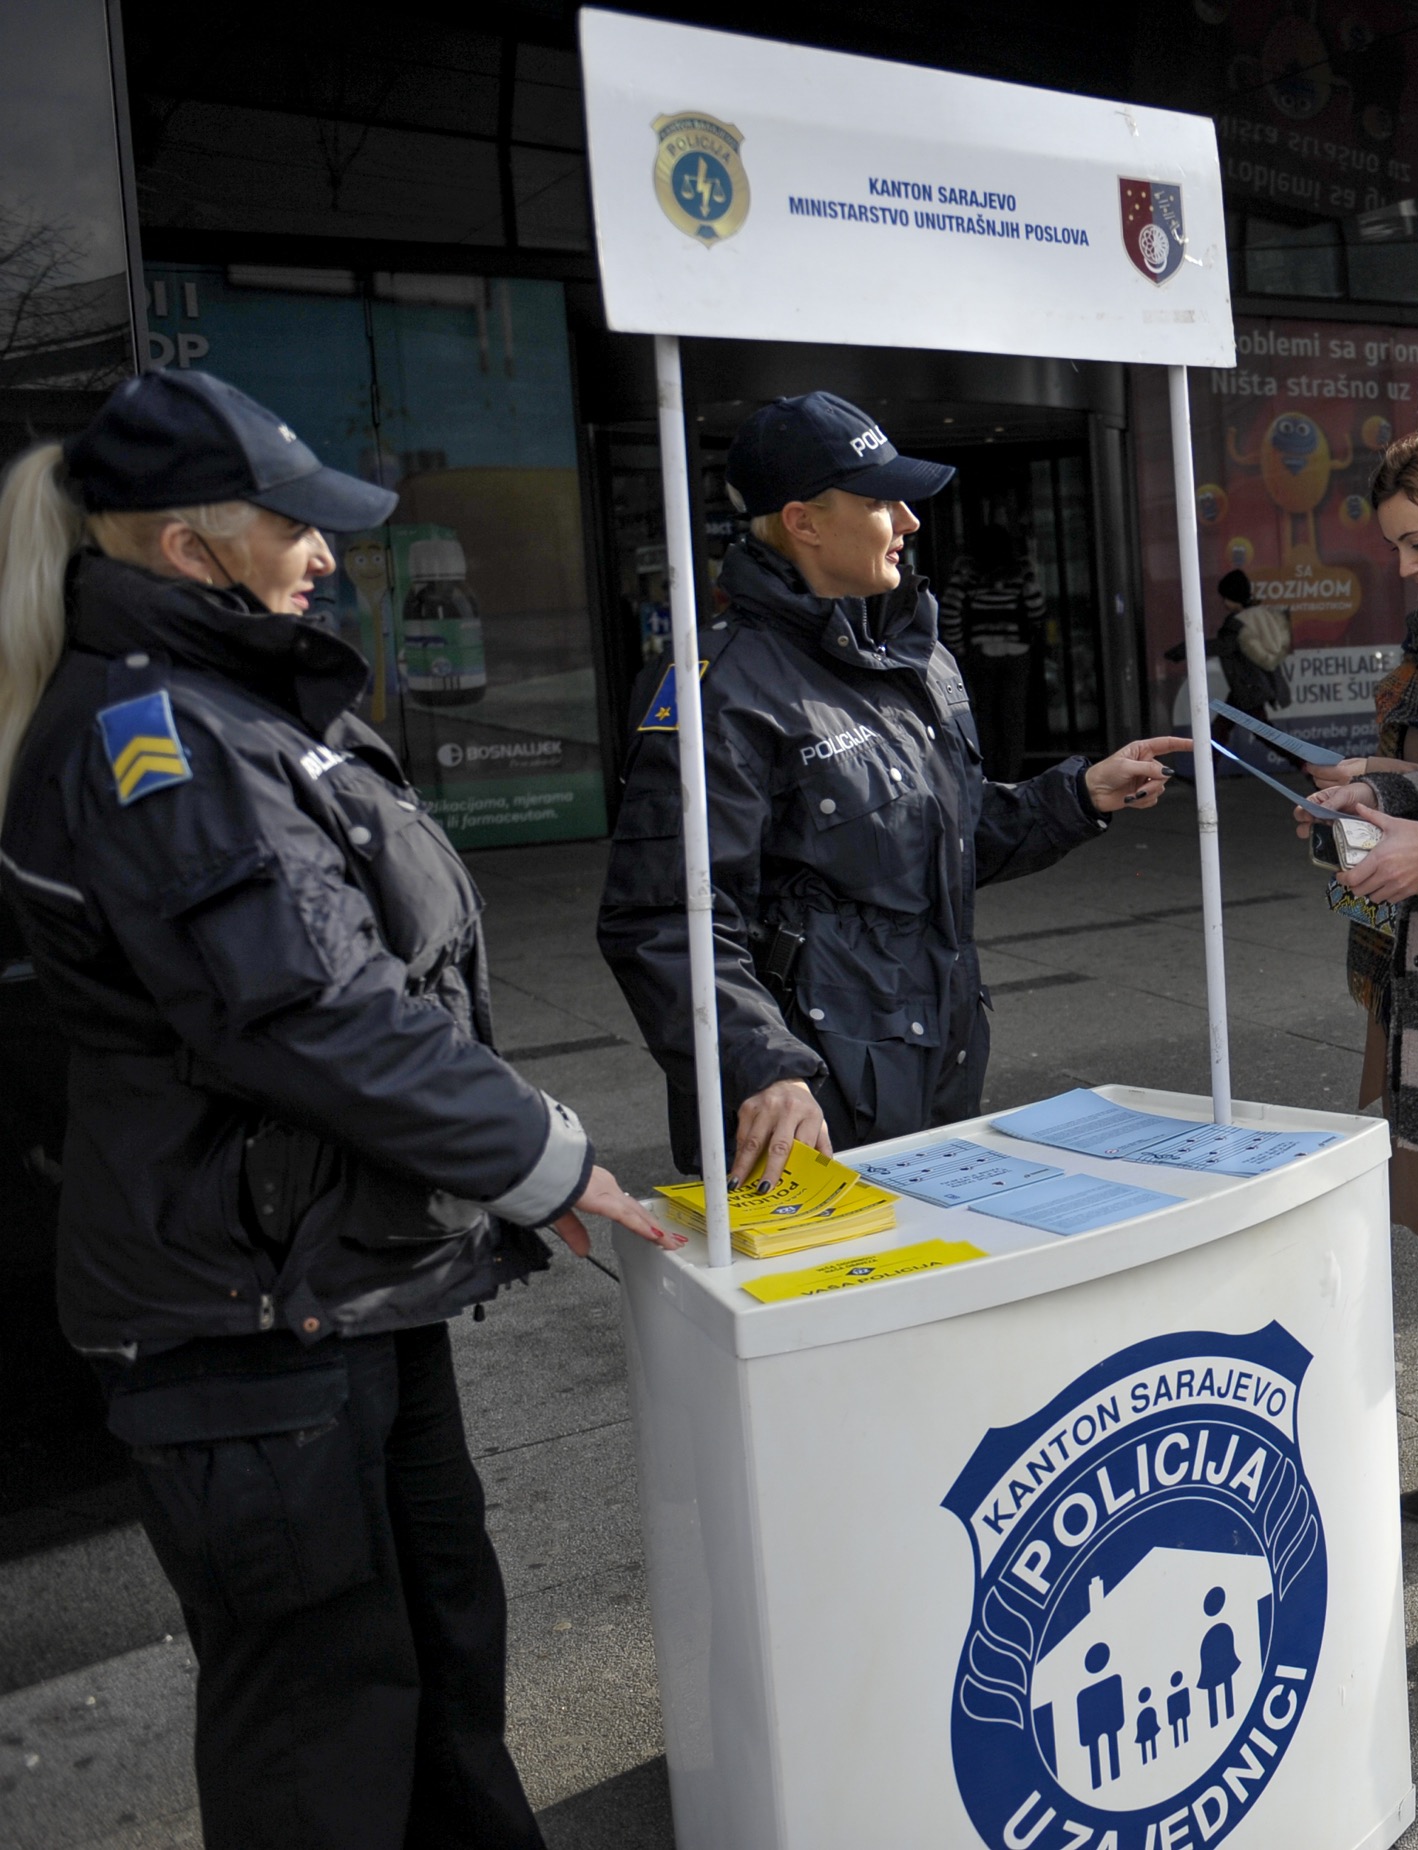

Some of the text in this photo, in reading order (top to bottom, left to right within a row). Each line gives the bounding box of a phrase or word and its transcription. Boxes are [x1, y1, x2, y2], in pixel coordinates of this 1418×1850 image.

[666, 135, 731, 162] POLICIJA
[869, 177, 1016, 212] KANTON SARAJEVO
[789, 196, 1090, 246] MINISTARSTVO UNUTRAŠNJIH POSLOVA
[1237, 330, 1320, 357] oblemi
[1329, 340, 1356, 359] sa
[1212, 370, 1277, 396] Ništa
[1287, 373, 1379, 400] strašno
[1388, 384, 1411, 401] uz
[1295, 564, 1313, 577] SA
[1250, 580, 1352, 600] IZOZIMOM
[1296, 682, 1342, 703] USNE
[466, 741, 562, 761] BOSNALIJEK
[800, 725, 878, 766] POLICIJA
[857, 1261, 943, 1284] POLICIJA
[982, 1368, 1287, 1536] KANTON SARAJEVO
[1011, 1430, 1267, 1595] POLICIJA
